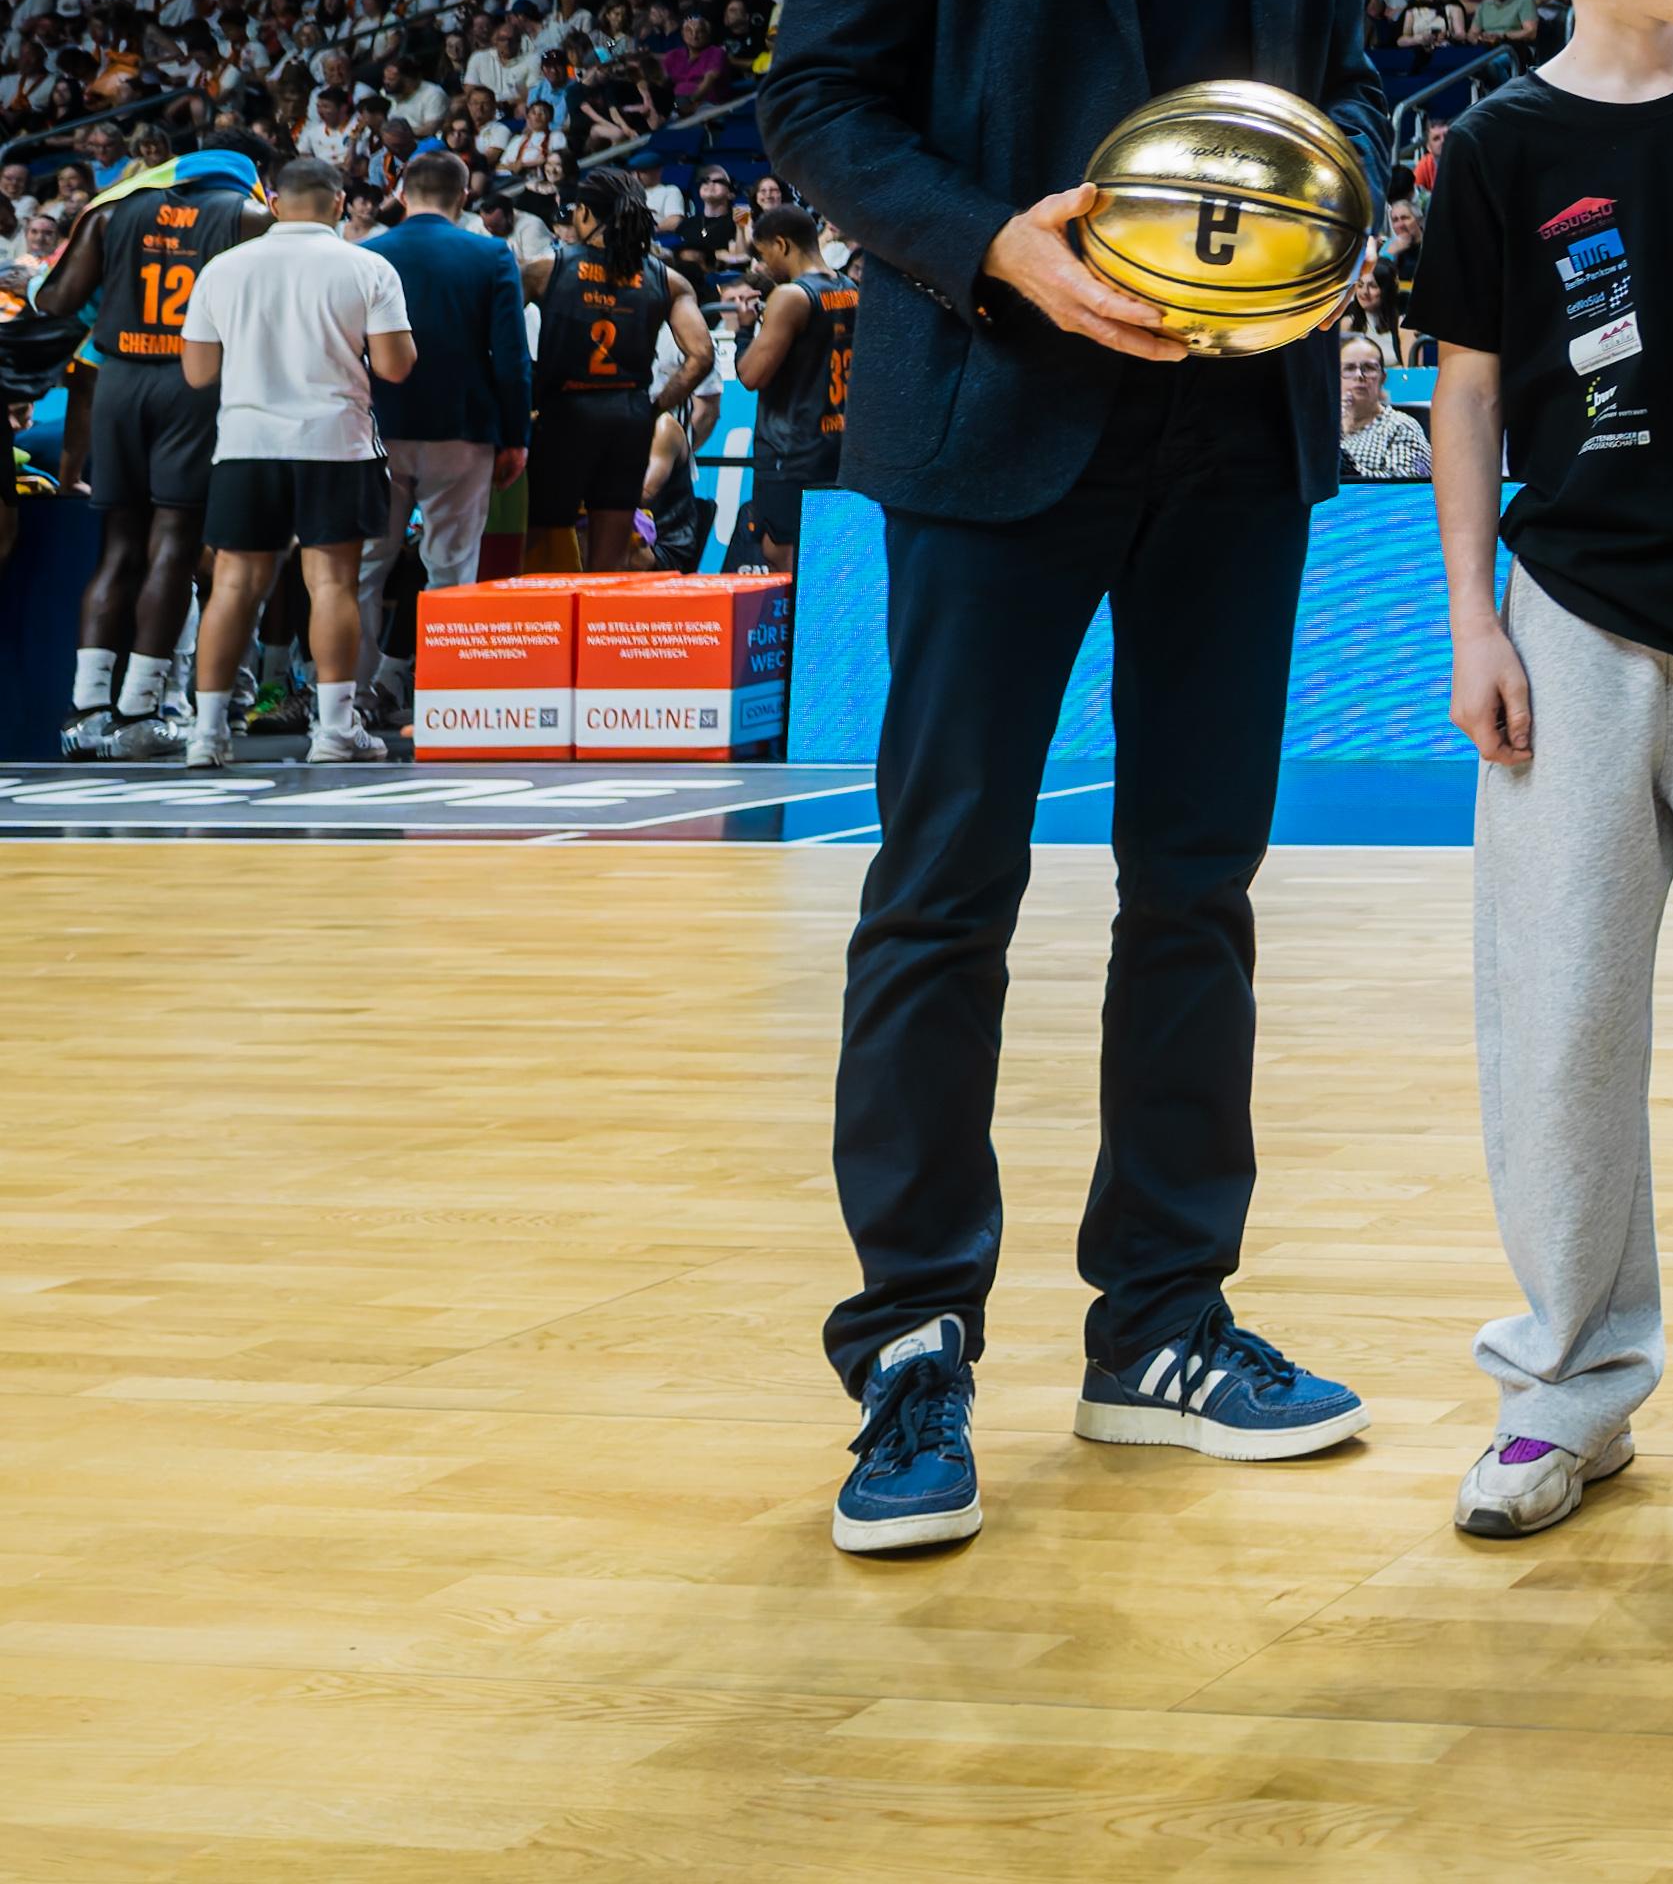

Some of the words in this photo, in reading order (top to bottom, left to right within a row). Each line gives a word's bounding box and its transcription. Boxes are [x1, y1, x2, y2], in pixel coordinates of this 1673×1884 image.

[140, 262, 197, 327] 12
[588, 318, 618, 375] 2
[747, 623, 778, 648] FÜR
